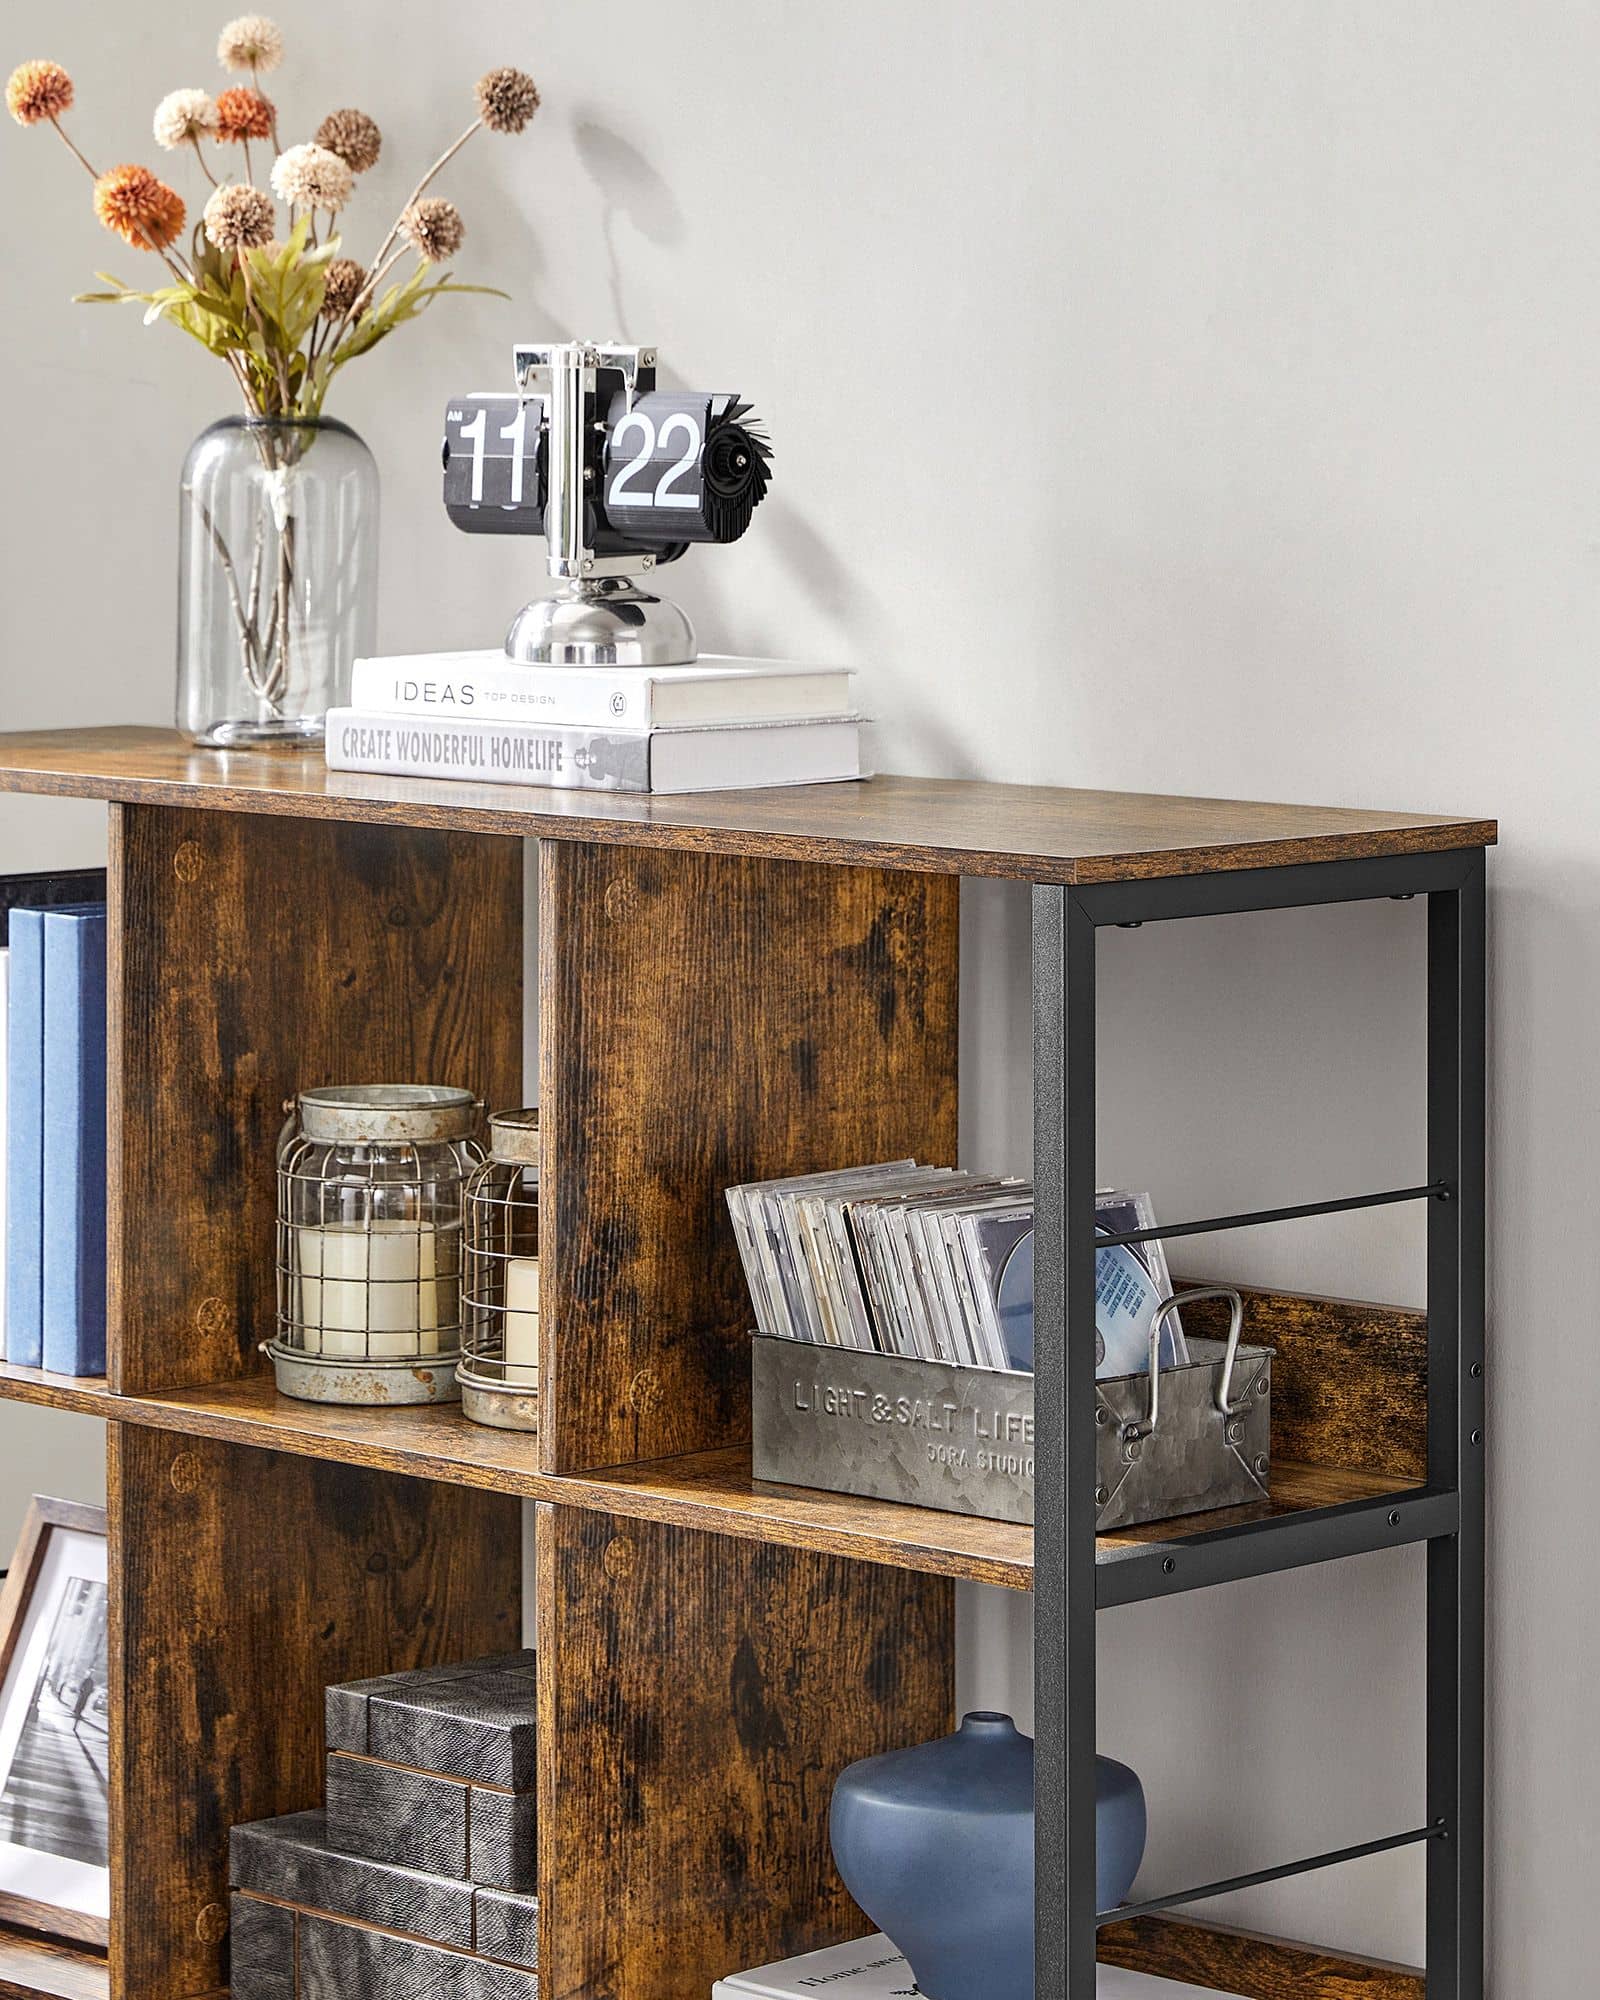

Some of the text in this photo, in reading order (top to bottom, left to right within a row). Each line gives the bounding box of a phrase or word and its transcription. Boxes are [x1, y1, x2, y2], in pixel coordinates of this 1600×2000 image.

[446, 410, 463, 422] AM
[460, 408, 701, 508] 11 22
[395, 680, 556, 705] IDEAS TOP DESIGN
[342, 727, 563, 772] CREATE WONDERFUL HOMELIFE
[797, 1966, 867, 1987] Home
